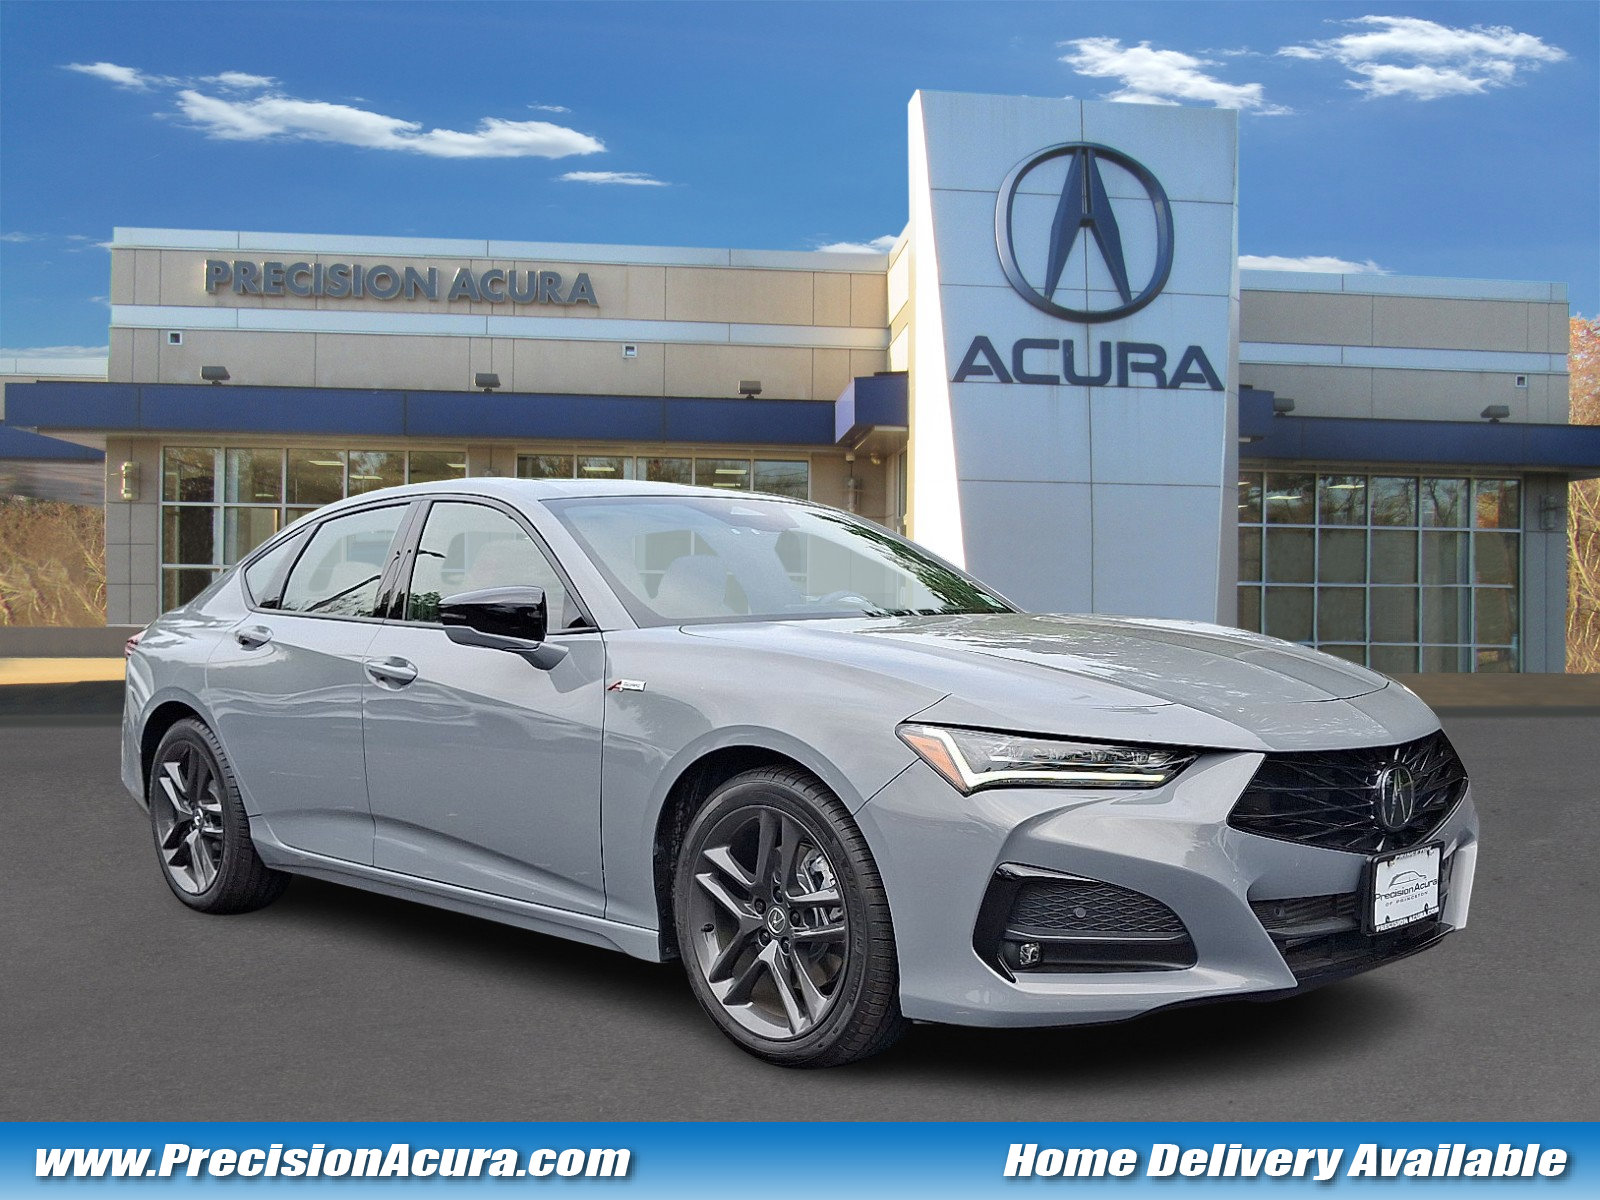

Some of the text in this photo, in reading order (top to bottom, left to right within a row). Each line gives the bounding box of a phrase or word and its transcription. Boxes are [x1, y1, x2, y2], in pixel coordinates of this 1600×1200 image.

[204, 259, 599, 307] PRECISION ACURA
[952, 335, 1225, 391] ACURA
